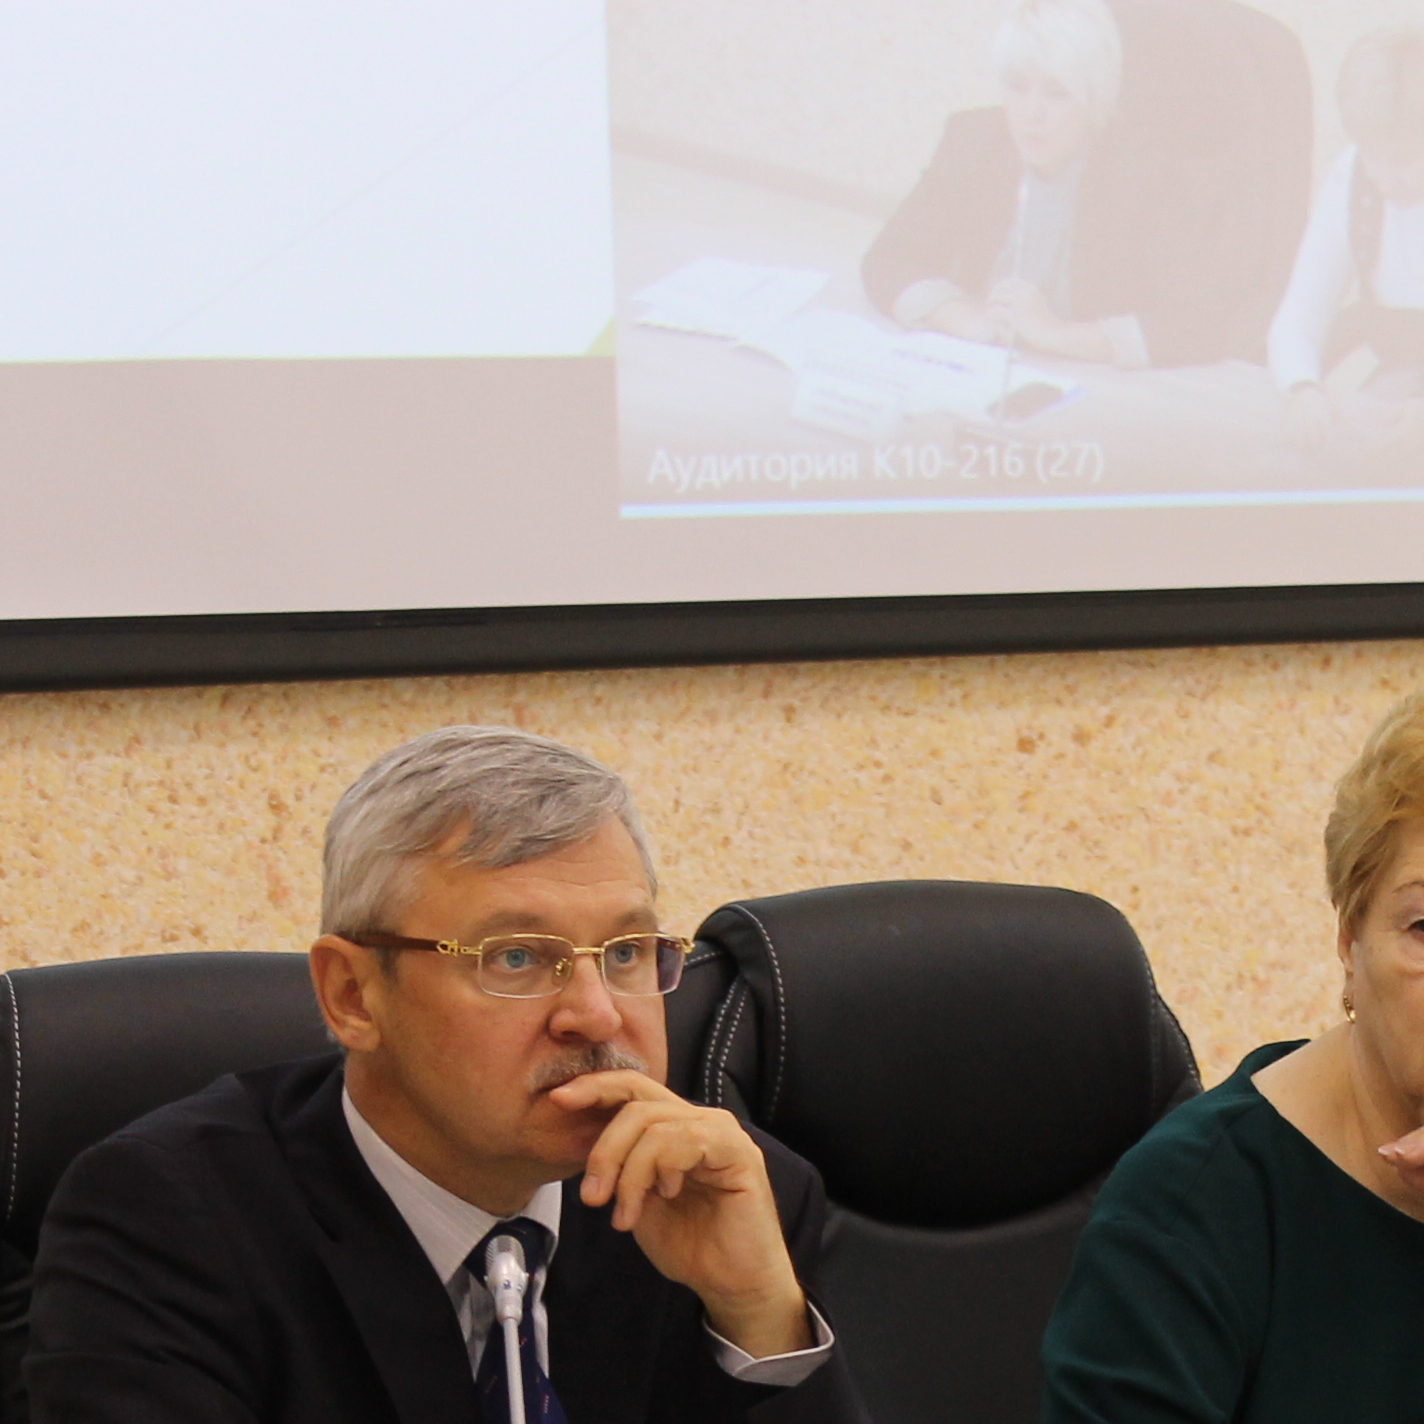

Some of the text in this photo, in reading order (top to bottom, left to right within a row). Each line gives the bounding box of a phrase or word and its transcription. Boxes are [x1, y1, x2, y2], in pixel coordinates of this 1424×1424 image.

[646, 440, 1106, 493] Аудитория К10-216 (27)
